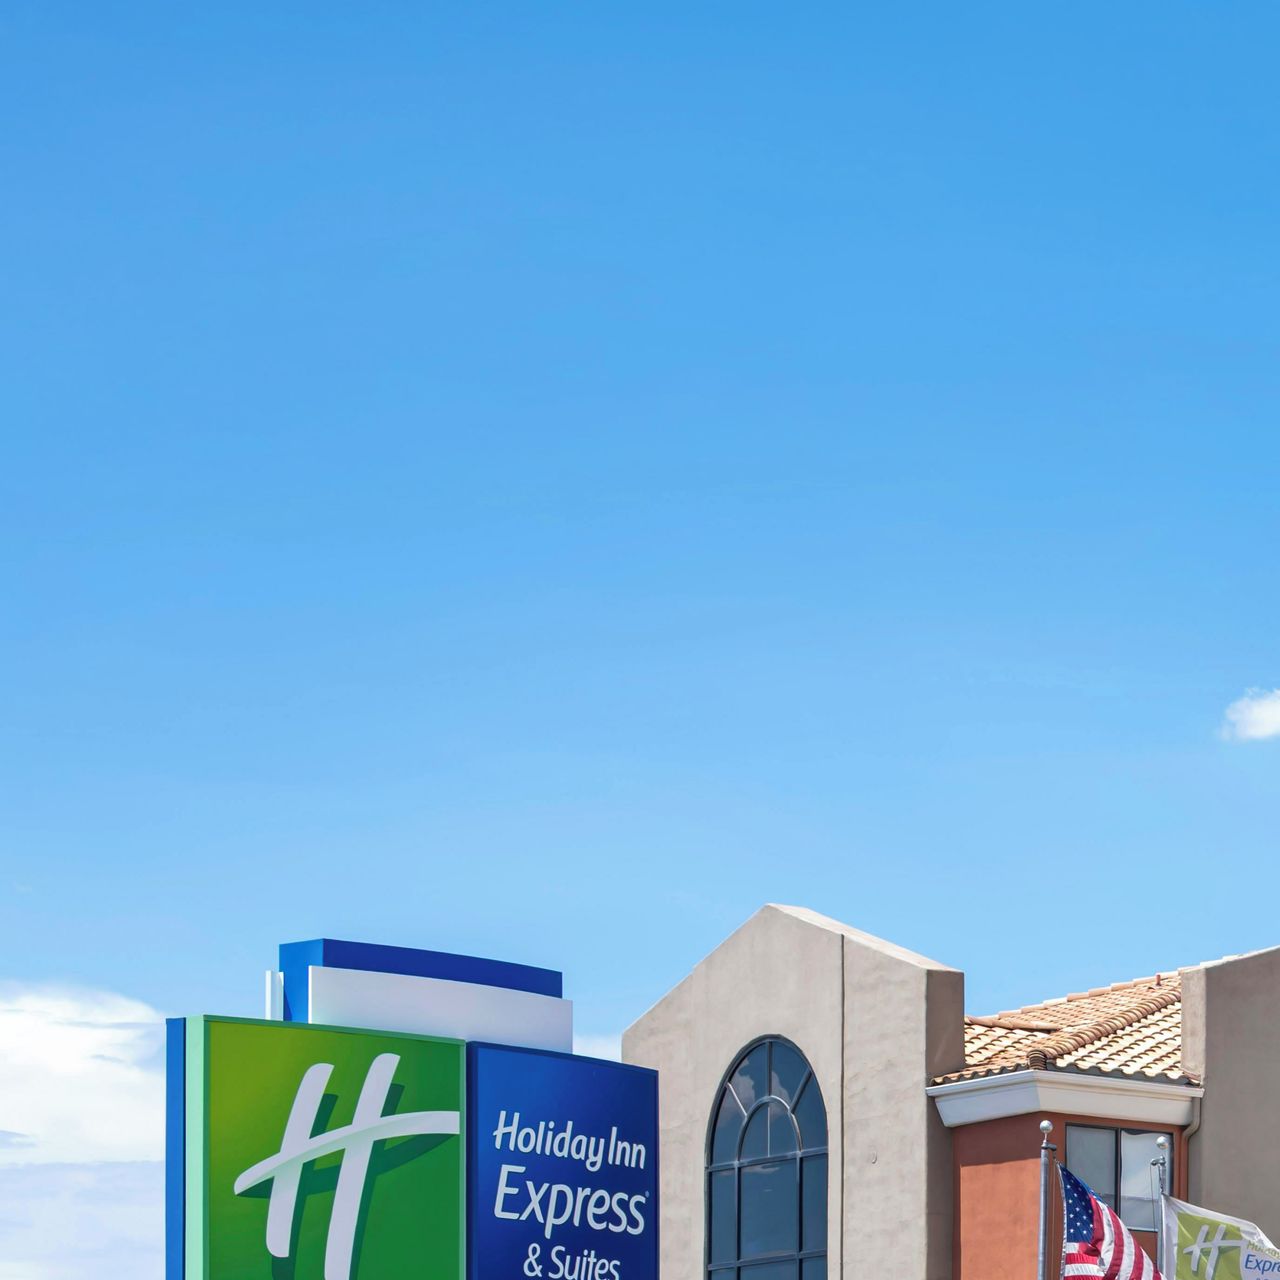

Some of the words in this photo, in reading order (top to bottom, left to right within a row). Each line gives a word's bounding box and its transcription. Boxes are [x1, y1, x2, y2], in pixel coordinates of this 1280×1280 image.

[493, 1110, 605, 1172] Holiday
[608, 1126, 646, 1169] Inn
[494, 1164, 646, 1239] Express
[523, 1242, 542, 1277] &
